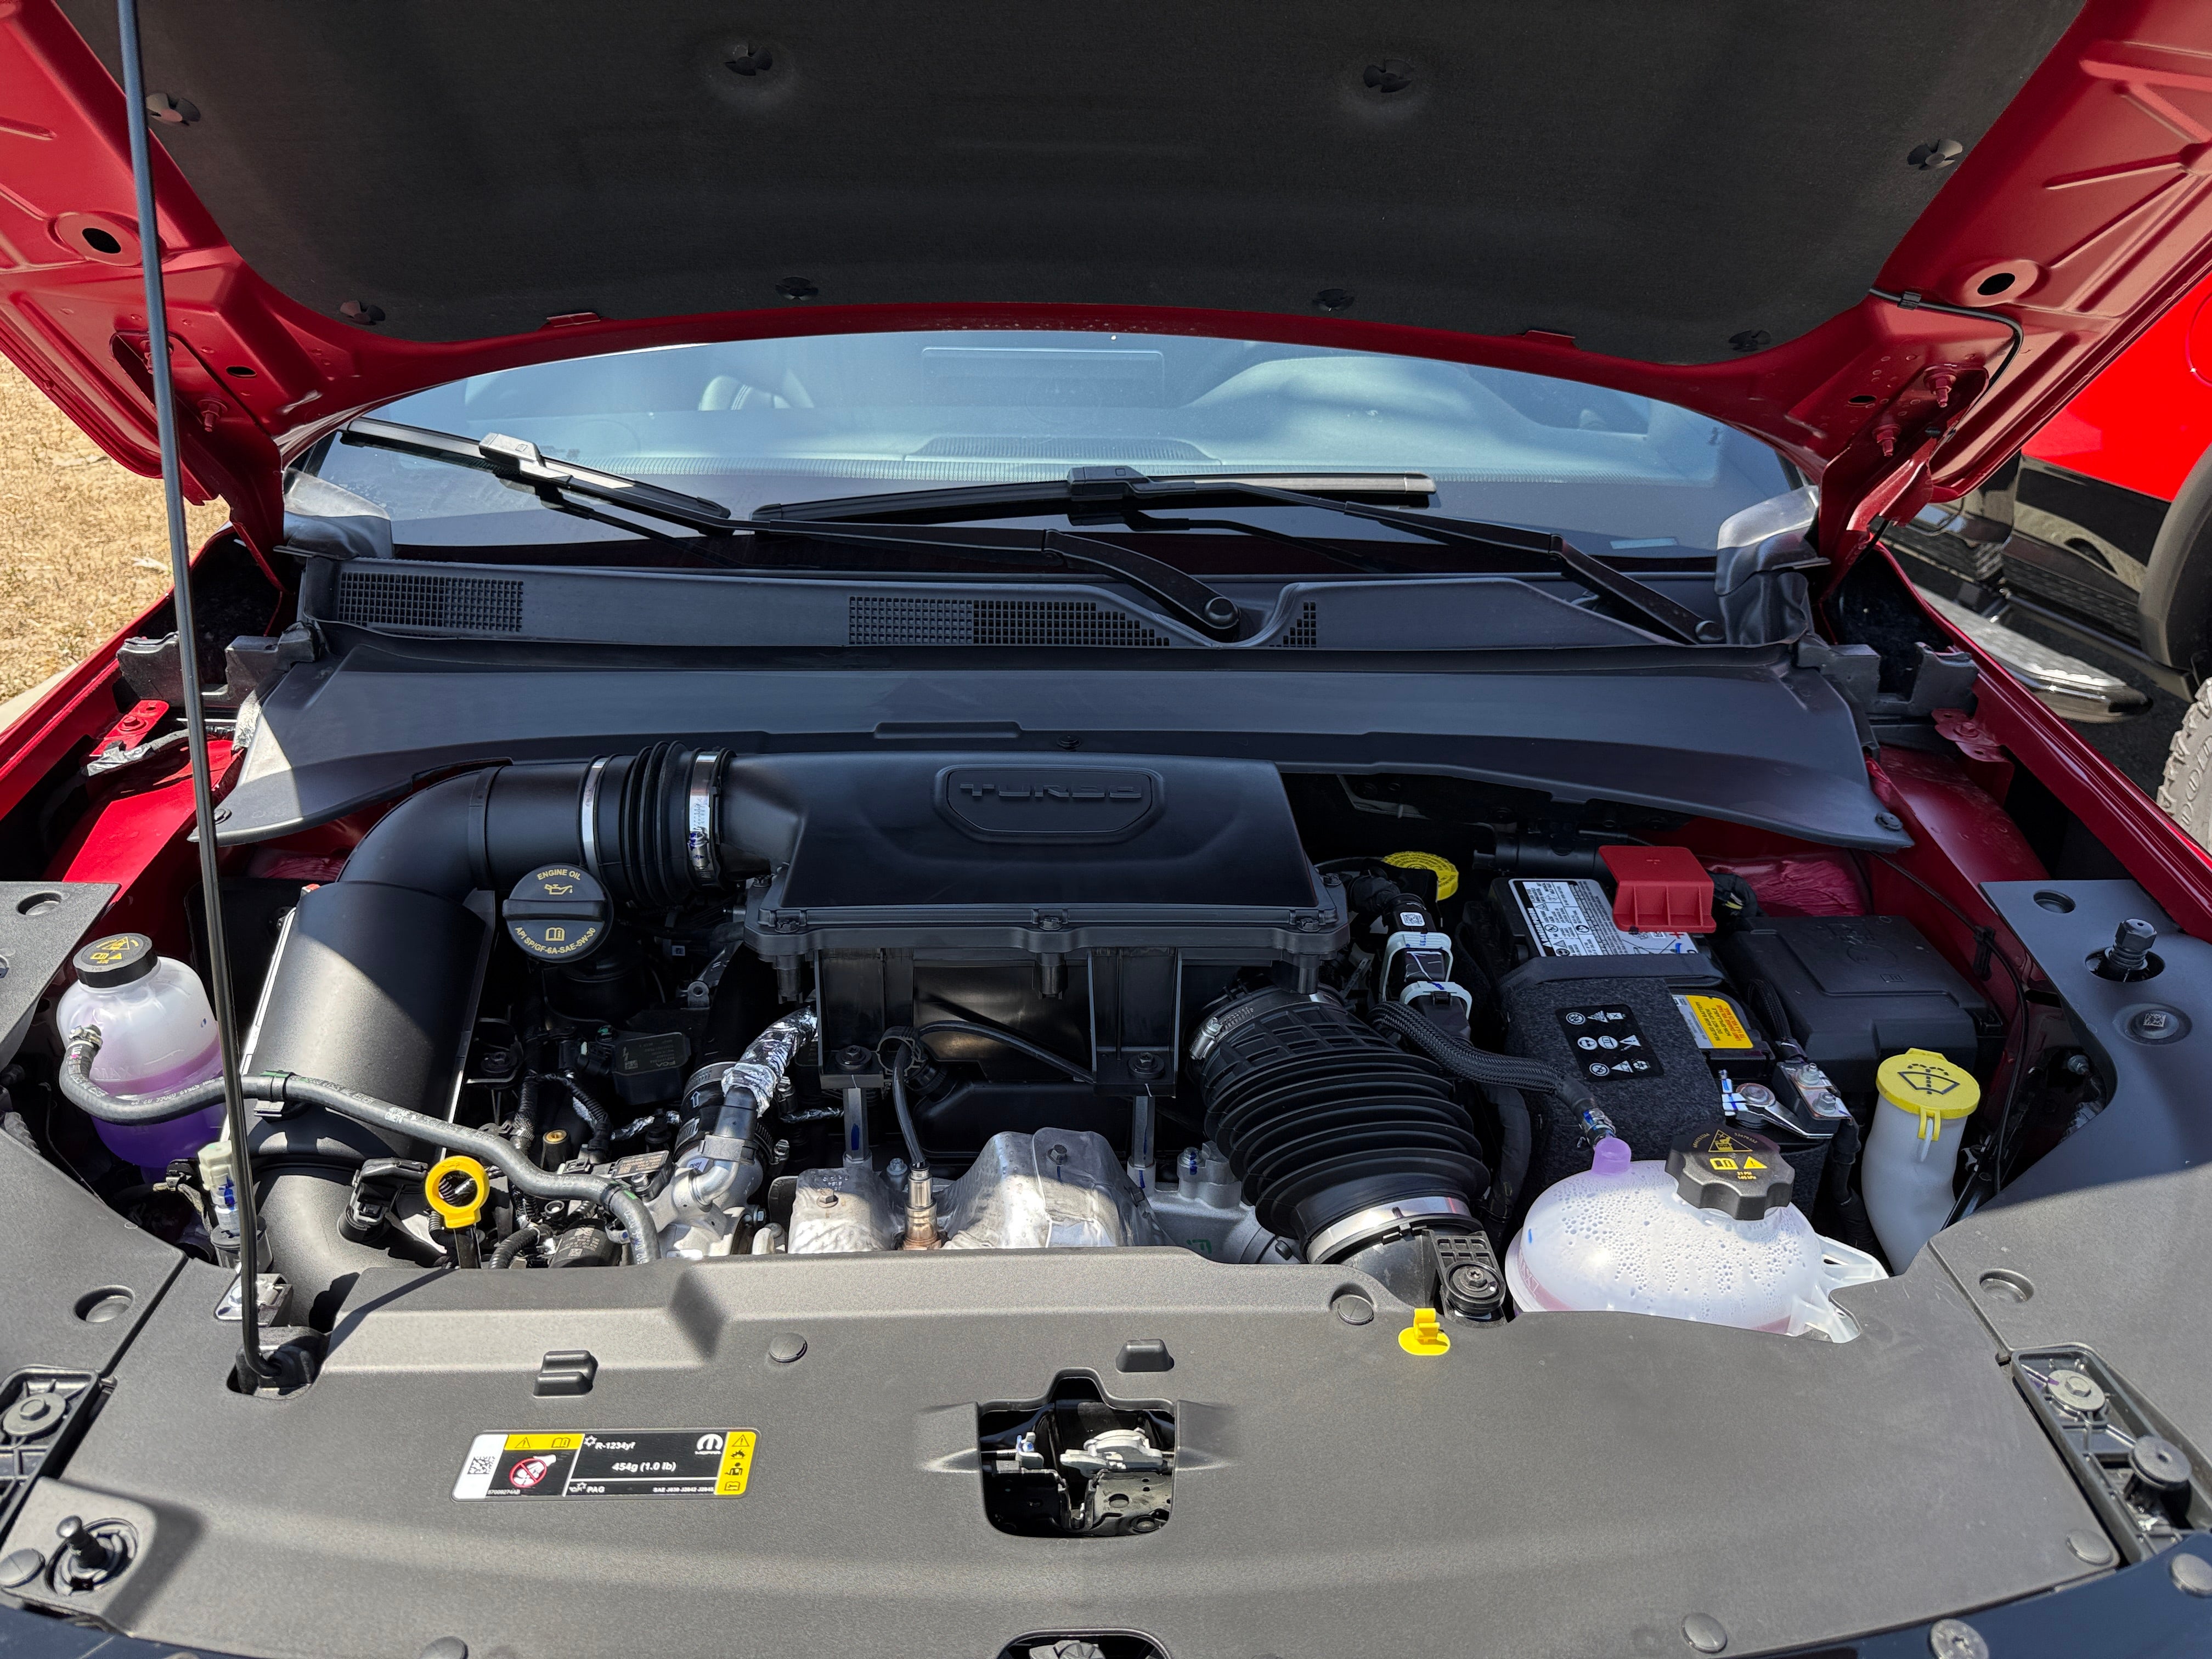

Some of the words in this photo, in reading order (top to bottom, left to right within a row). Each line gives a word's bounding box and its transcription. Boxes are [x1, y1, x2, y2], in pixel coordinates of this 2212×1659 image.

[960, 783, 1142, 798] TURBO
[537, 868, 568, 881] ENGINE
[569, 871, 582, 881] OIL
[515, 927, 526, 939] API
[524, 927, 596, 954] SP/GF-6A-SAE-5W-30
[1695, 1002, 1707, 1017] BATTERY
[595, 1442, 636, 1451] R-1234yf
[612, 1462, 639, 1472] 454g
[640, 1462, 660, 1472] (1.0
[662, 1462, 677, 1472] lb)
